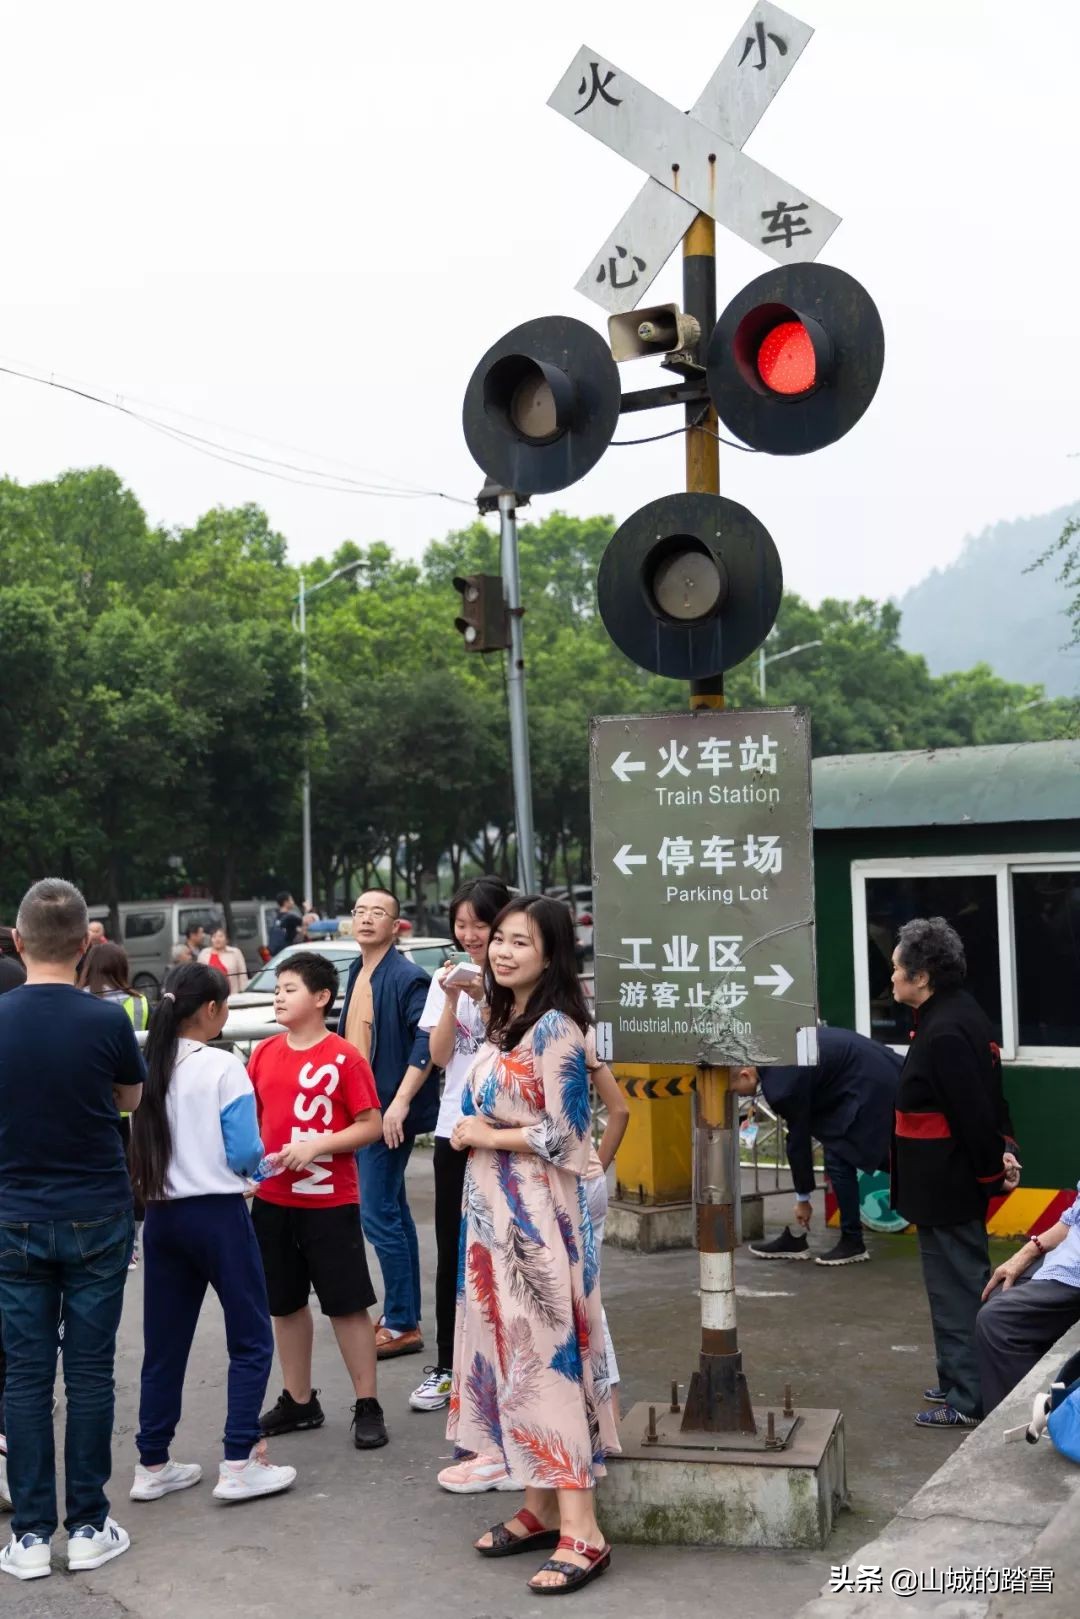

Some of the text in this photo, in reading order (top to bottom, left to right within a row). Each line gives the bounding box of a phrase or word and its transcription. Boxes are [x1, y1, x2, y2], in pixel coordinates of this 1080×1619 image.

[574, 62, 812, 248] 火 车
[596, 22, 788, 289] 小 心
[656, 734, 778, 778] 火车站
[655, 784, 780, 805] Train Station
[657, 834, 782, 876] 停车场
[666, 885, 768, 904] Parking Lot
[619, 935, 746, 972] 工业区
[619, 982, 749, 1009] 游客止步
